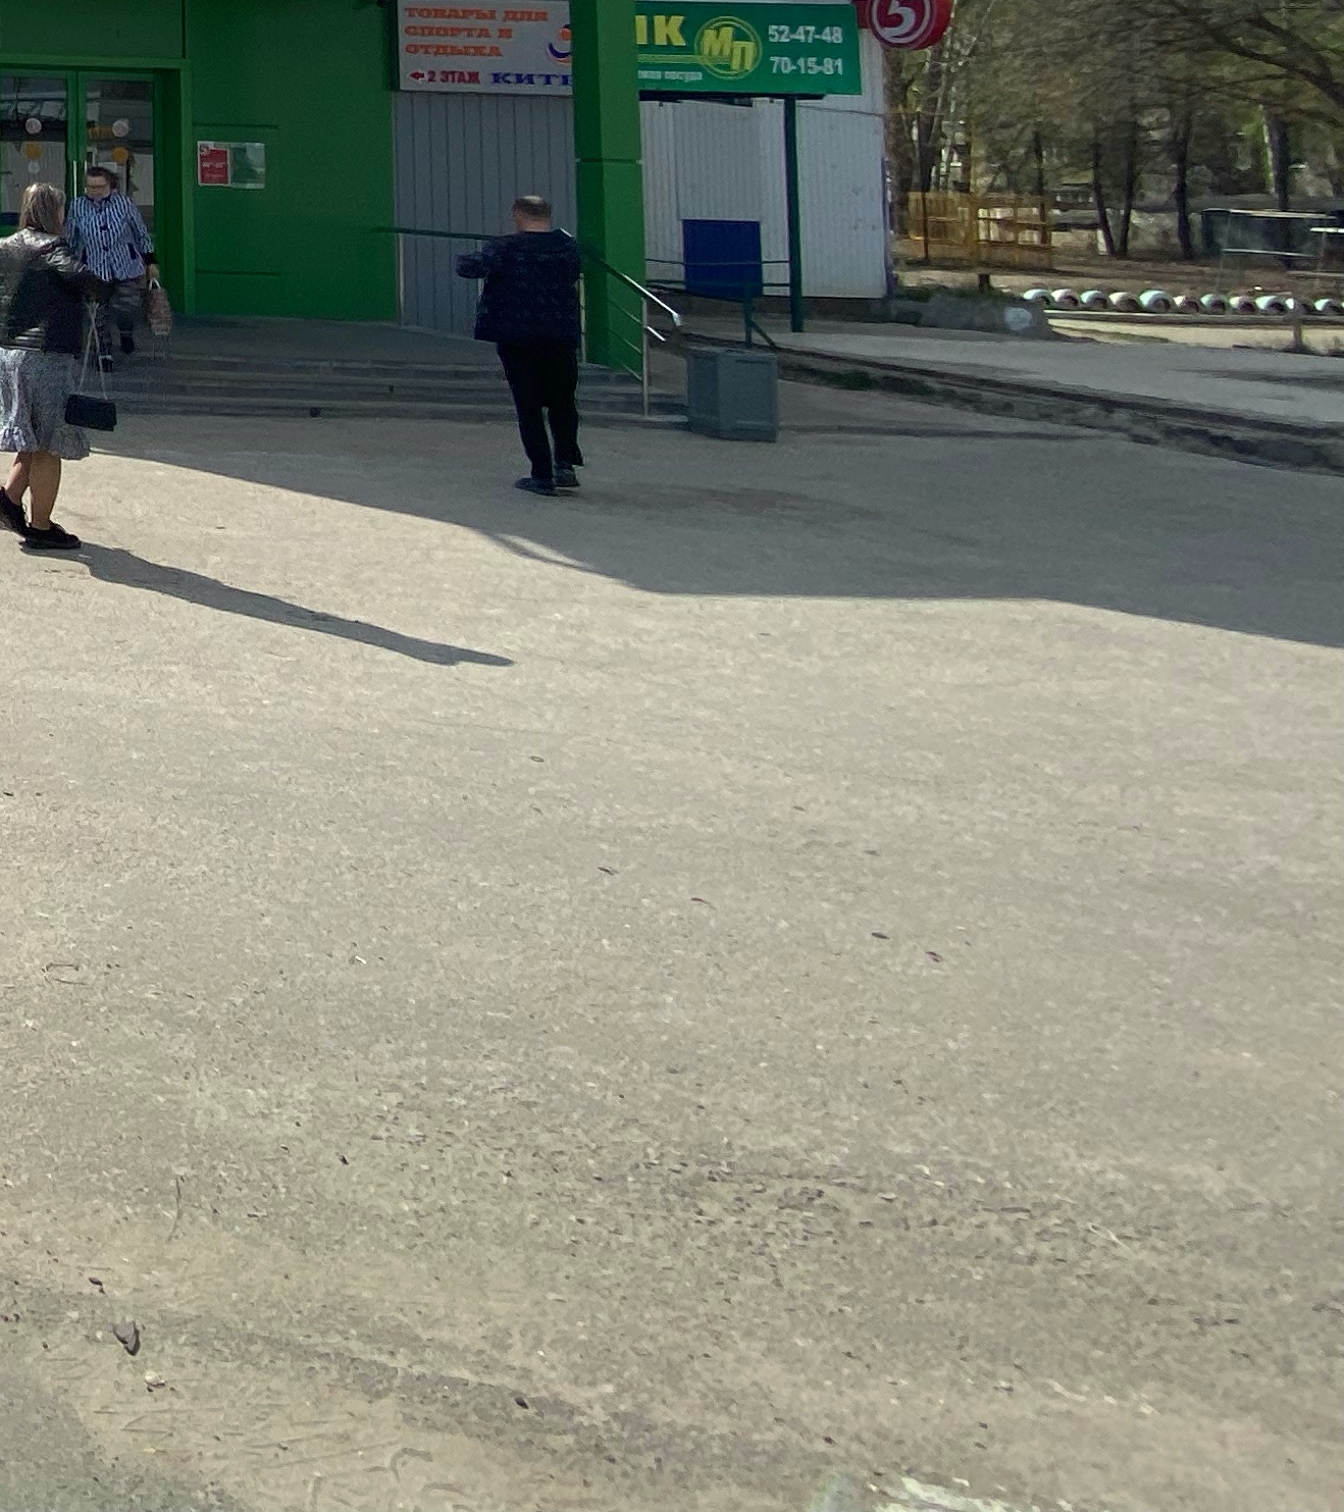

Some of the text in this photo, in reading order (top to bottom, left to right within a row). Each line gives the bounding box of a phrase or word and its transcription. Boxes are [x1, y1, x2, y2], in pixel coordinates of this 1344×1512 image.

[404, 7, 548, 22] ТОВАРЫ ДЛЯ
[404, 25, 492, 38] СПОРТА
[768, 25, 844, 44] 52-47-48
[405, 43, 504, 57] ОТДЫХА
[769, 56, 844, 75] 70-15-81
[427, 71, 436, 83] 2
[440, 71, 481, 84] ЭТАЖ
